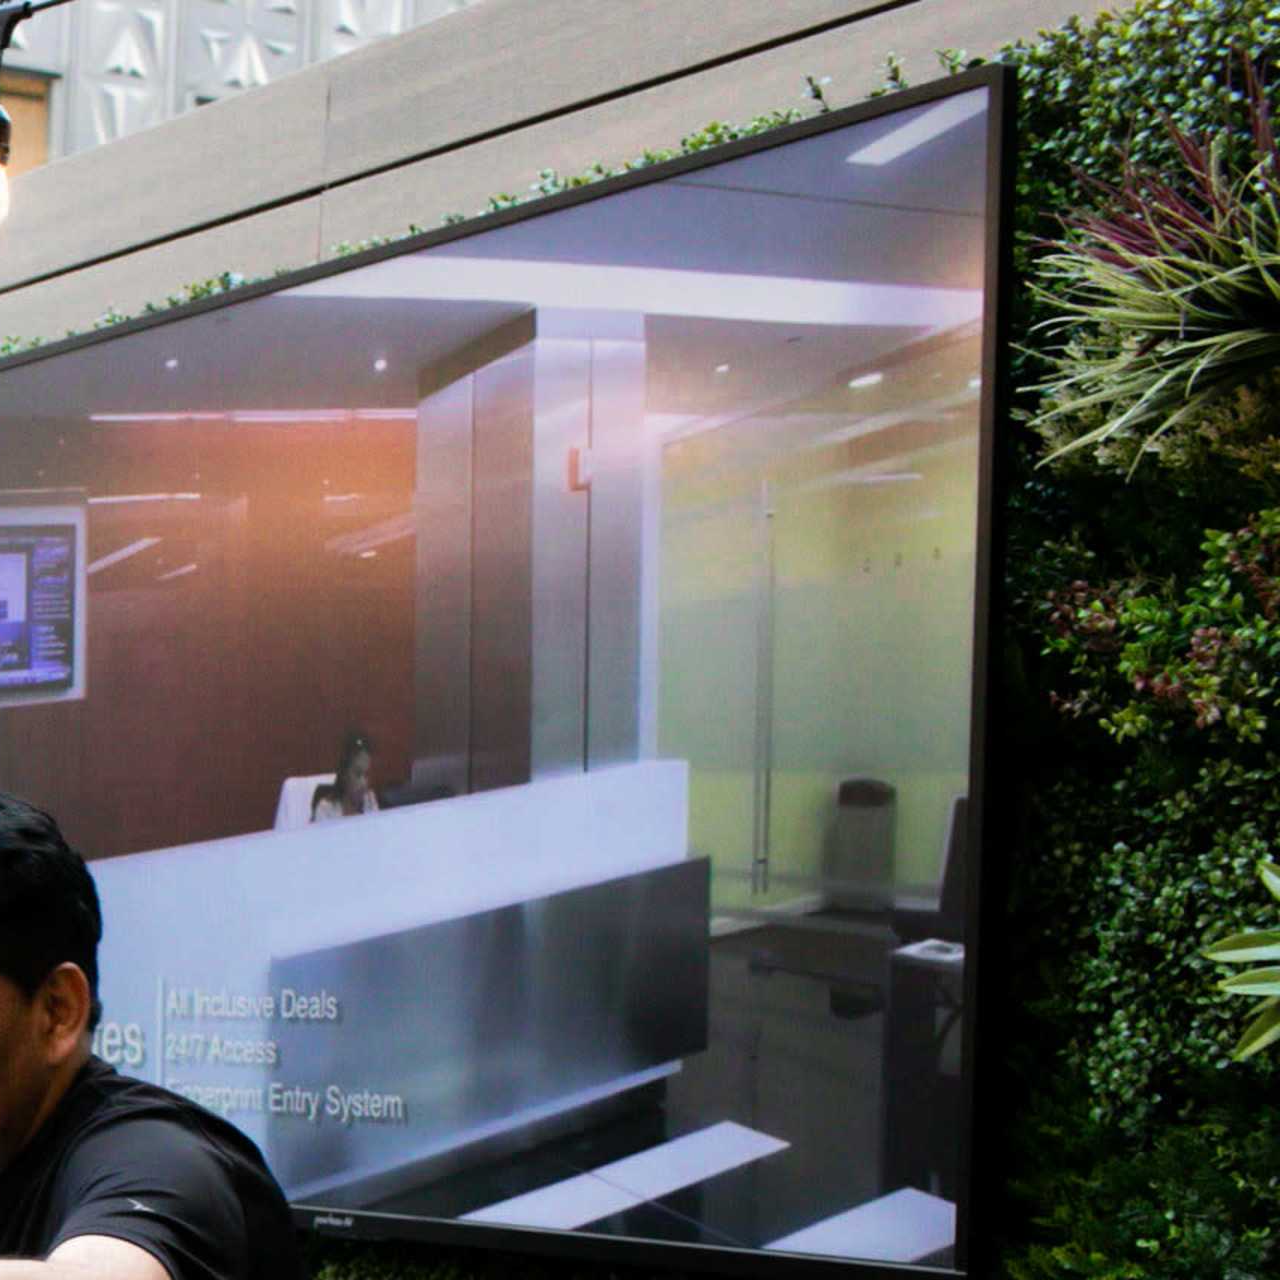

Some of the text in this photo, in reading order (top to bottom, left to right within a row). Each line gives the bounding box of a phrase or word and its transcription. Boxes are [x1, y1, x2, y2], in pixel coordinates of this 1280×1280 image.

[166, 988, 339, 1020] All Inclusive Deals
[165, 1033, 278, 1065] 24/7 Access
[268, 1082, 321, 1121] Entry
[325, 1085, 404, 1123] System
